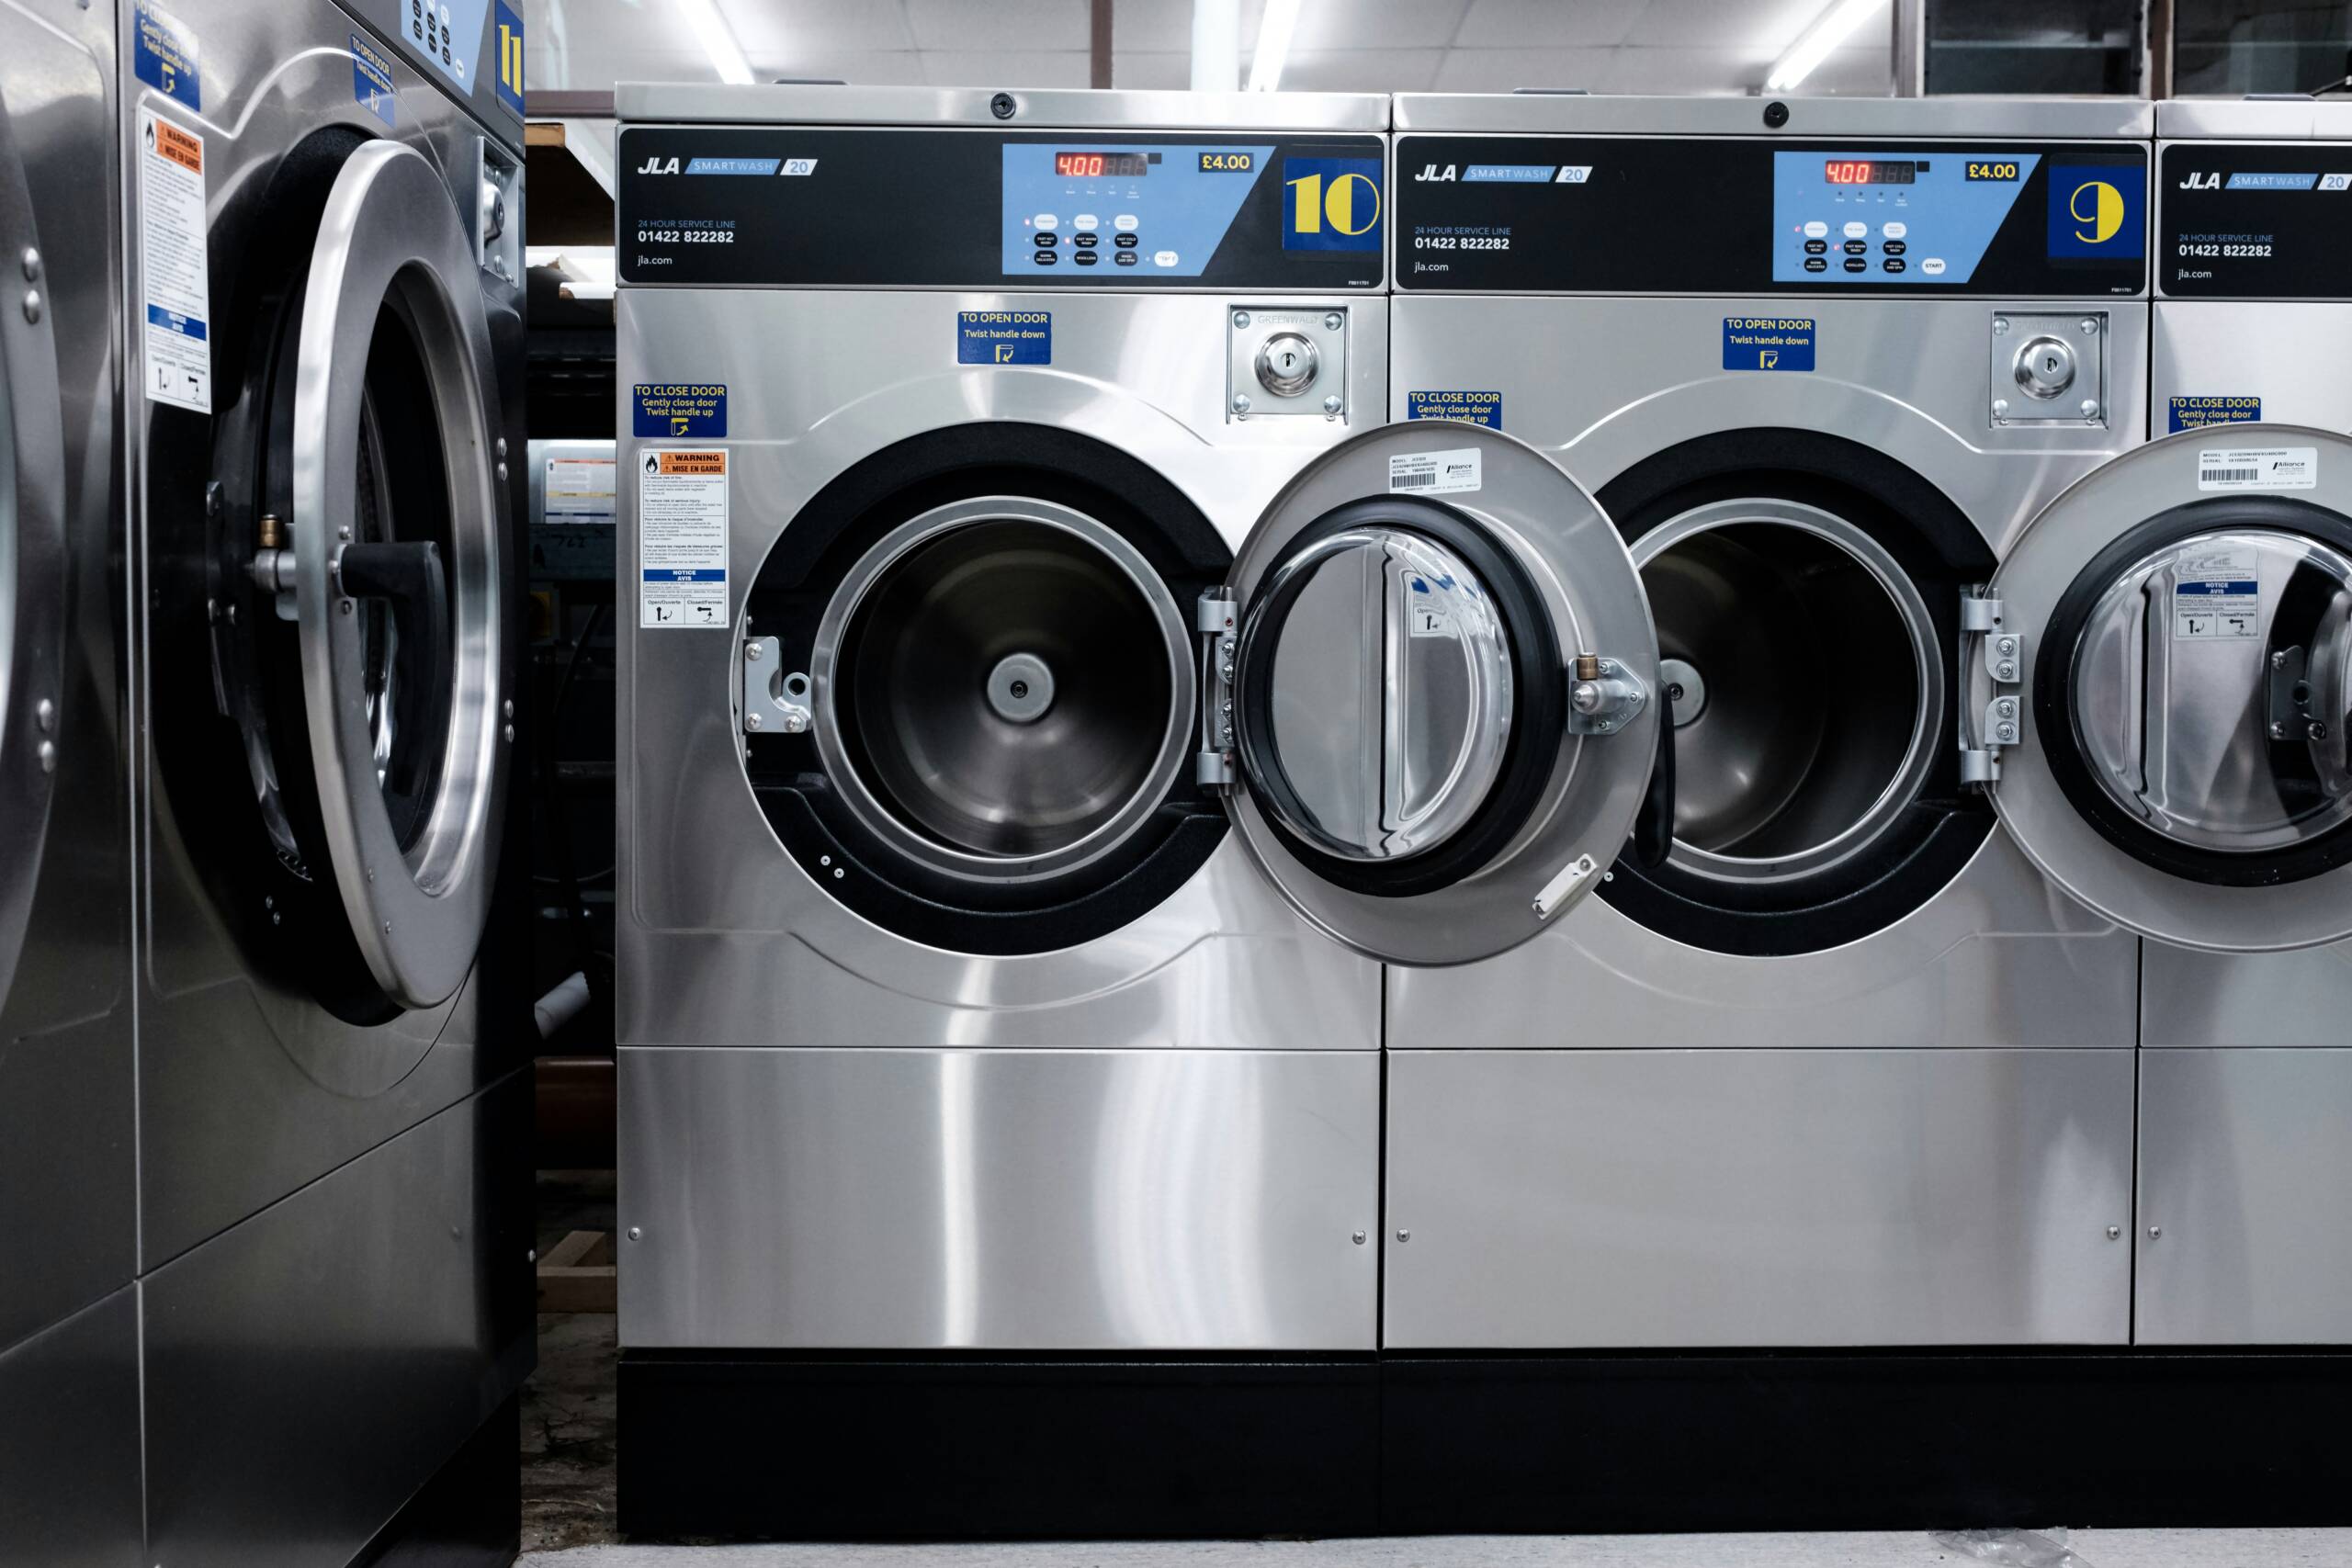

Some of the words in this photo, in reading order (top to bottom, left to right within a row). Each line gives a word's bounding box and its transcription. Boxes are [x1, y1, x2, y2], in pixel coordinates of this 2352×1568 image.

[352, 36, 360, 52] TO
[361, 44, 375, 63] OPEN
[376, 55, 390, 75] DOOR
[499, 25, 522, 97] 11
[166, 128, 198, 152] WARNING
[638, 157, 680, 175] JLA
[790, 162, 808, 173] 20
[1059, 157, 1102, 176] 4.00
[1203, 154, 1250, 169] £4.00
[1415, 164, 1456, 182] JLA
[1565, 169, 1583, 181] 20
[1826, 164, 1869, 183] 4.00
[1969, 164, 2016, 178] £4.00
[2179, 172, 2220, 189] JLA
[2326, 176, 2344, 188] 20
[1286, 174, 1380, 235] 10
[2070, 181, 2124, 243] 9
[638, 220, 648, 229] 24
[650, 220, 675, 229] HOUR
[678, 220, 713, 229] SERVICE
[717, 220, 735, 229] LINE
[1415, 227, 1424, 235] 24
[1427, 227, 1453, 235] HOUR
[1454, 227, 1489, 235] SERVICE
[1492, 227, 1511, 235] LINE
[638, 231, 680, 243] 01422
[684, 231, 734, 243] 822282
[2179, 234, 2188, 243] 24
[2191, 234, 2215, 243] HOUR
[2218, 234, 2251, 243] SERVICE
[2255, 234, 2273, 243] LINE
[1415, 238, 1456, 249] 01422
[1460, 238, 1510, 250] 822282
[2179, 245, 2219, 256] 01422
[2223, 245, 2271, 256] 822282
[638, 255, 673, 266] jla.com
[1414, 262, 1449, 273] jla.com
[2178, 268, 2211, 280] jla.com
[961, 313, 978, 322] TO
[980, 313, 1011, 322] OPEN
[1014, 313, 1047, 323] DOOR
[1258, 315, 1317, 324] GREENWALD
[1726, 320, 1742, 329] TO
[1746, 320, 1776, 330] OPEN
[1779, 321, 1812, 330] DOOR
[965, 330, 988, 338] Twist
[989, 330, 1019, 338] handle
[1021, 330, 1046, 338] down
[1729, 335, 1753, 344] Twist
[1755, 335, 1783, 344] handle
[1785, 336, 1809, 345] down
[635, 386, 650, 395] TO
[653, 386, 689, 396] CLOSE
[691, 387, 725, 396] DOOR
[642, 399, 671, 408] Gently
[696, 399, 718, 407] door
[1410, 393, 1426, 402] TO
[1429, 393, 1464, 402] CLOSE
[1466, 393, 1499, 403] DOOR
[2171, 398, 2187, 408] TO
[2189, 398, 2223, 408] CLOSE
[2226, 398, 2259, 408] DOOR
[671, 408, 700, 416] handle
[703, 410, 713, 418] up
[1418, 405, 1446, 414] Gently
[1447, 405, 1469, 413] close
[1471, 405, 1492, 413] door
[1477, 416, 1488, 424] up
[2178, 411, 2206, 420] Gently
